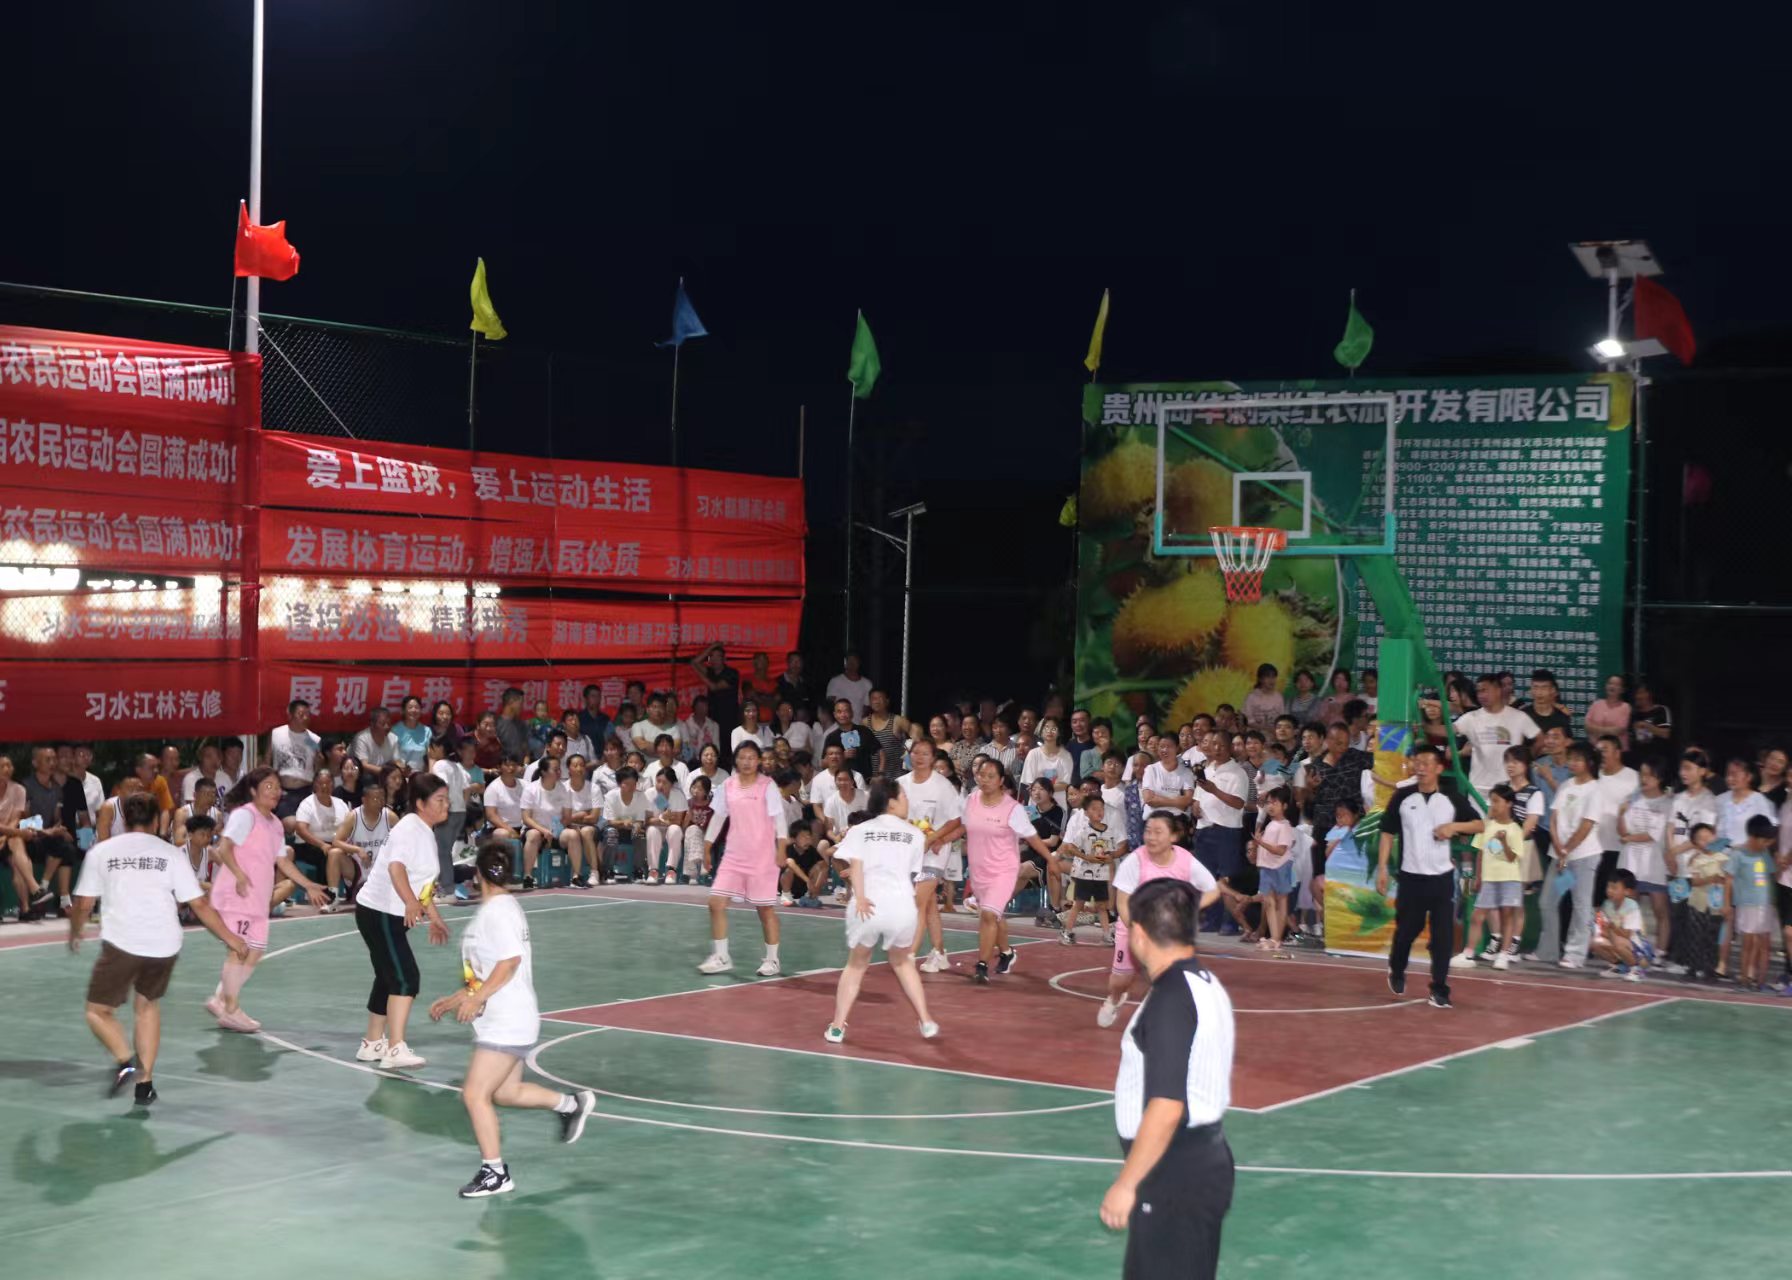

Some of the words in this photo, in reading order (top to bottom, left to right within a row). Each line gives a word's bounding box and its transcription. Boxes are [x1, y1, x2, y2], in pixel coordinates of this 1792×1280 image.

[0, 341, 236, 405] 农民运动会圆满成功！
[86, 690, 222, 721] 习水江林汽修
[107, 856, 168, 872] 共兴能源
[237, 920, 250, 935] 12
[1117, 950, 1124, 963] 9
